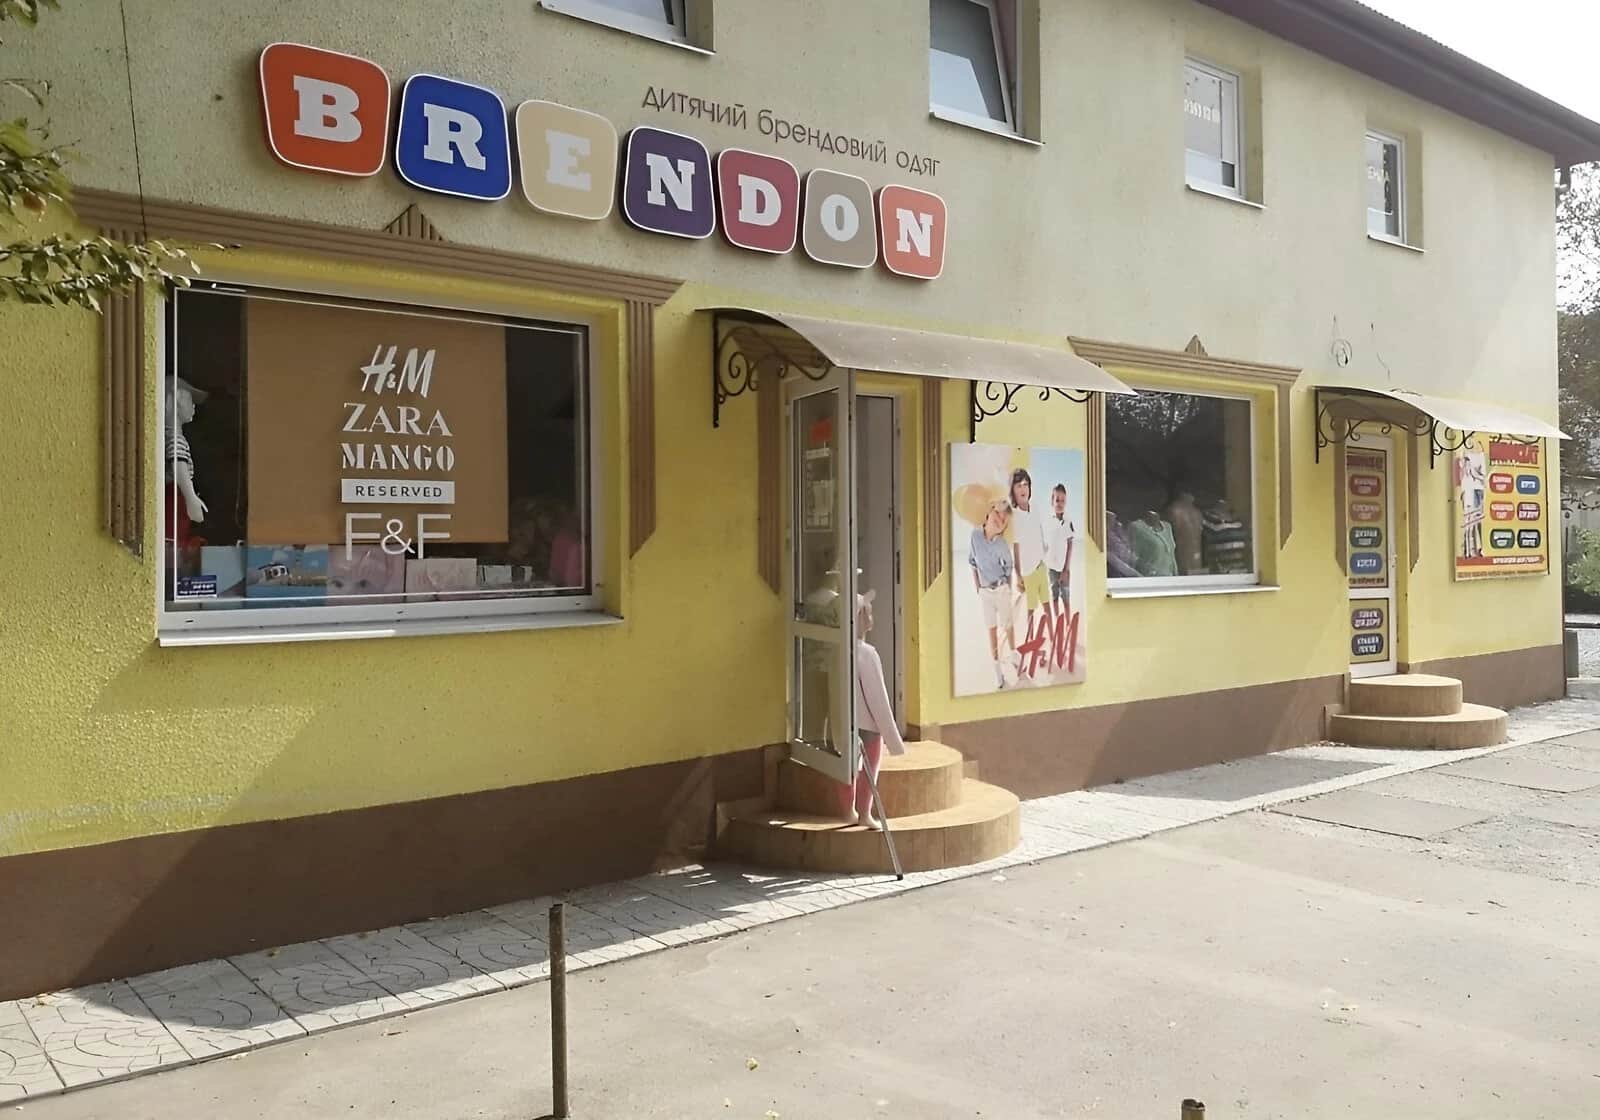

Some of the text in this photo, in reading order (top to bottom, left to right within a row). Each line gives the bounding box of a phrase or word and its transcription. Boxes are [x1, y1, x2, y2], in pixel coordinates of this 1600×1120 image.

[642, 86, 941, 178] дитячий брендовий одяг
[292, 75, 933, 257] BRENDON
[360, 343, 437, 399] H&M
[342, 401, 453, 437] ZARA
[340, 443, 455, 472] MANGO
[355, 484, 443, 498] RESERVED
[345, 512, 452, 562] F&F
[1016, 611, 1080, 679] H&M
